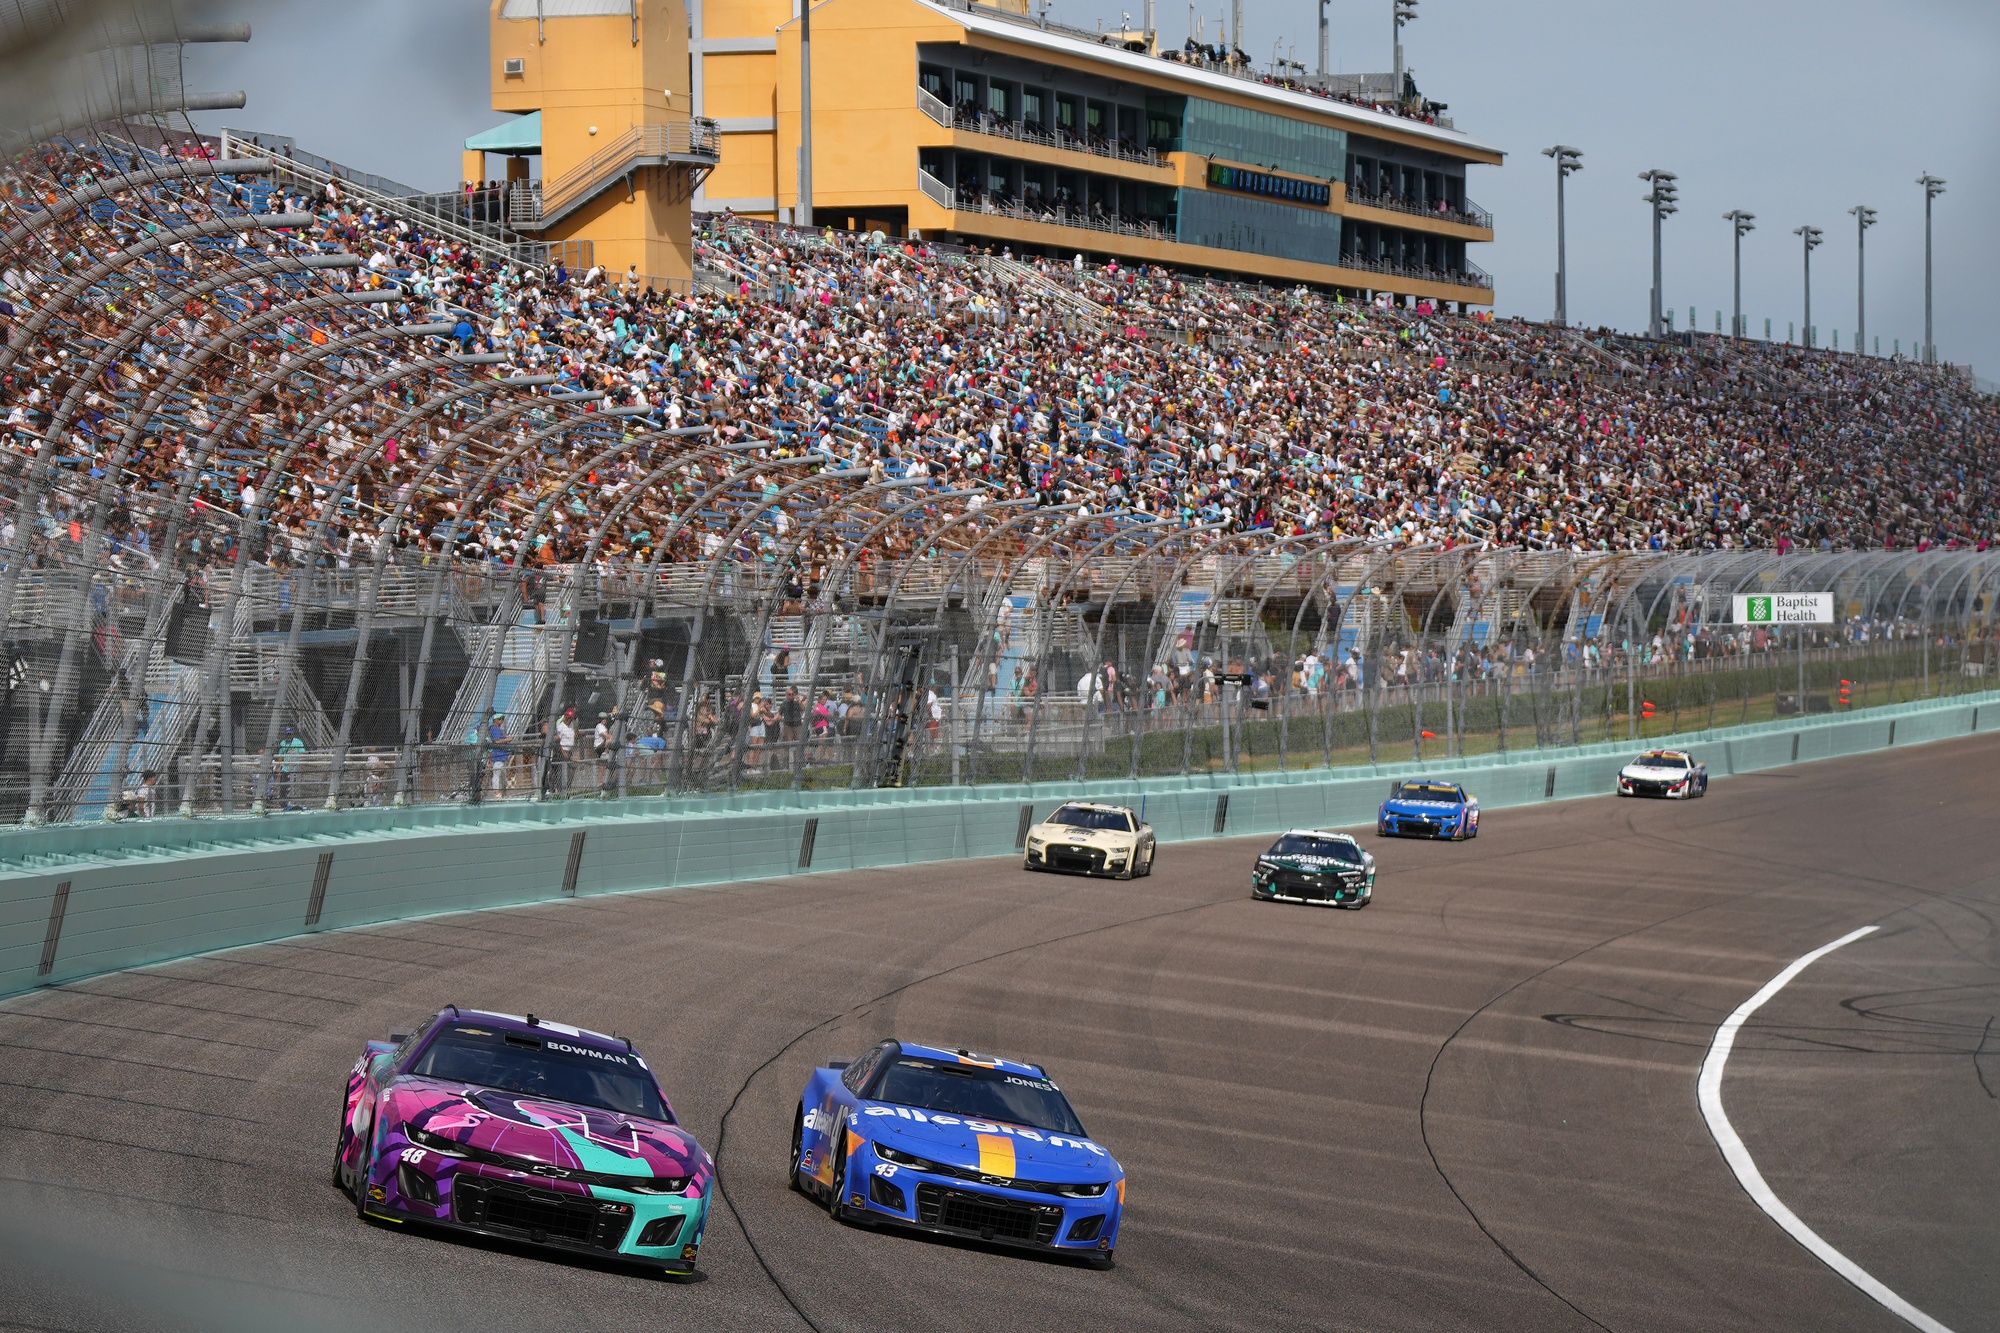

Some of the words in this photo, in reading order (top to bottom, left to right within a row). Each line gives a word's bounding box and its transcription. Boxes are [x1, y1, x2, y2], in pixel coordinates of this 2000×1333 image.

[1777, 595, 1817, 610] Baptist
[1777, 610, 1817, 621] Health
[547, 1041, 628, 1065] BOWMAN
[1004, 1076, 1052, 1091] JONES
[864, 1106, 1105, 1157] allegiant
[400, 1147, 427, 1164] 48
[875, 1163, 898, 1178] 43
